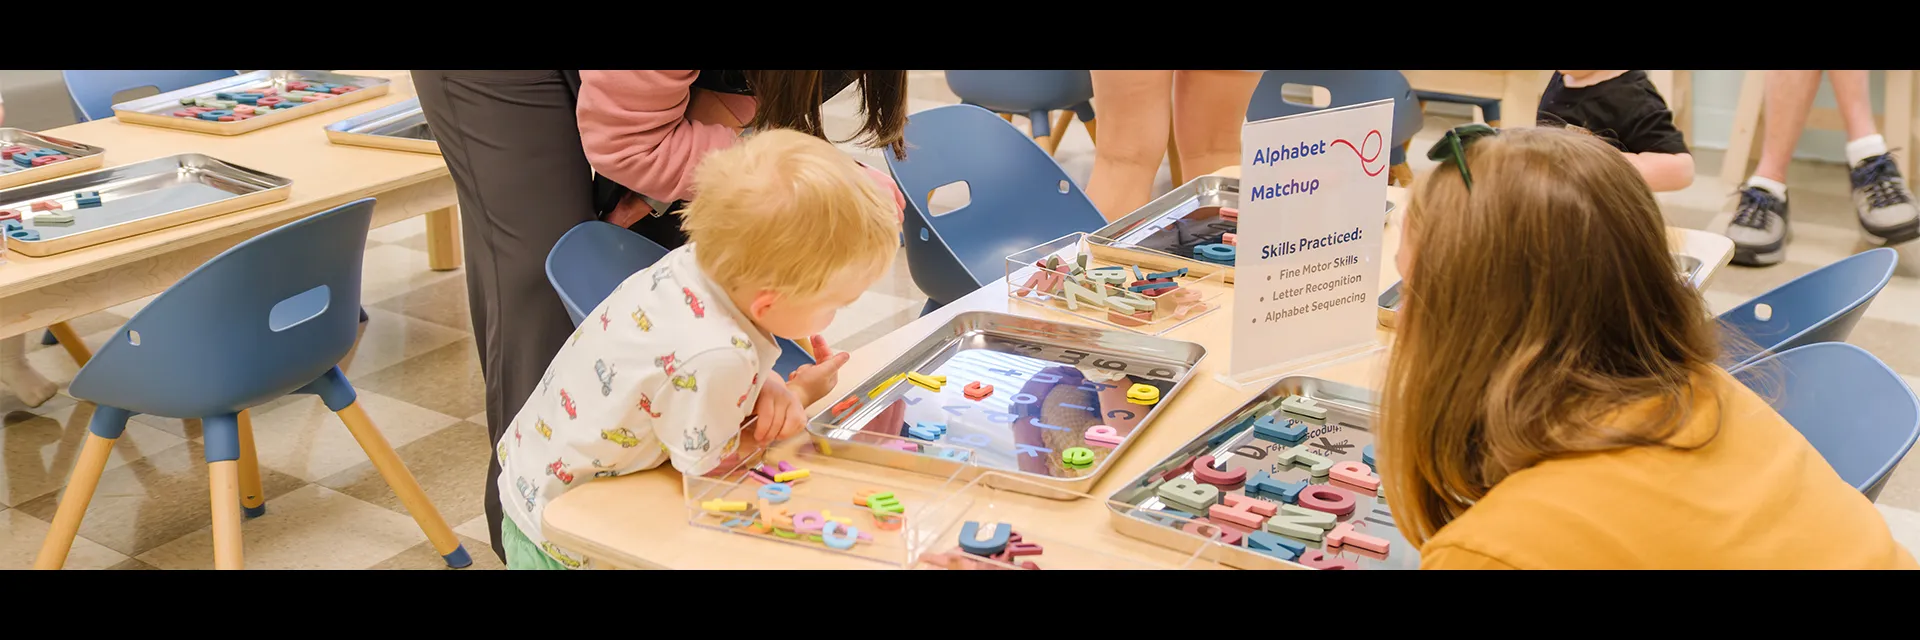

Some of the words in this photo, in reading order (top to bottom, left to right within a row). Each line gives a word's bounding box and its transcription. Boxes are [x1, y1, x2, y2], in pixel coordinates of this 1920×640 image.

[1253, 140, 1326, 166] Alphabet
[1251, 178, 1320, 201] Matchup
[1261, 242, 1296, 259] Skills
[1299, 227, 1362, 251] Practiced:
[1280, 269, 1301, 280] Fine
[1302, 261, 1332, 275] Motor
[1333, 255, 1358, 268] Skills
[1272, 287, 1304, 301] Letter
[1305, 274, 1362, 294] Recognition
[1265, 304, 1309, 322] Alphabet
[1311, 292, 1366, 312] Sequencing
[1058, 350, 1090, 365] m
[1092, 358, 1127, 371] g
[988, 367, 1023, 377] t
[1147, 367, 1176, 379] a
[1010, 393, 1037, 404] o
[1280, 394, 1328, 420] F
[1107, 409, 1135, 420] c
[1253, 415, 1308, 442] E
[1062, 447, 1094, 465] e
[1235, 445, 1269, 460] D
[1193, 455, 1247, 485] C
[1329, 461, 1381, 491] P
[1158, 477, 1219, 510] B
[1209, 493, 1278, 530] H
[1245, 471, 1309, 502] I
[1278, 445, 1335, 477] J
[1298, 485, 1356, 516] O
[1267, 504, 1338, 542] N
[959, 521, 1012, 556] U
[1326, 523, 1391, 554] T
